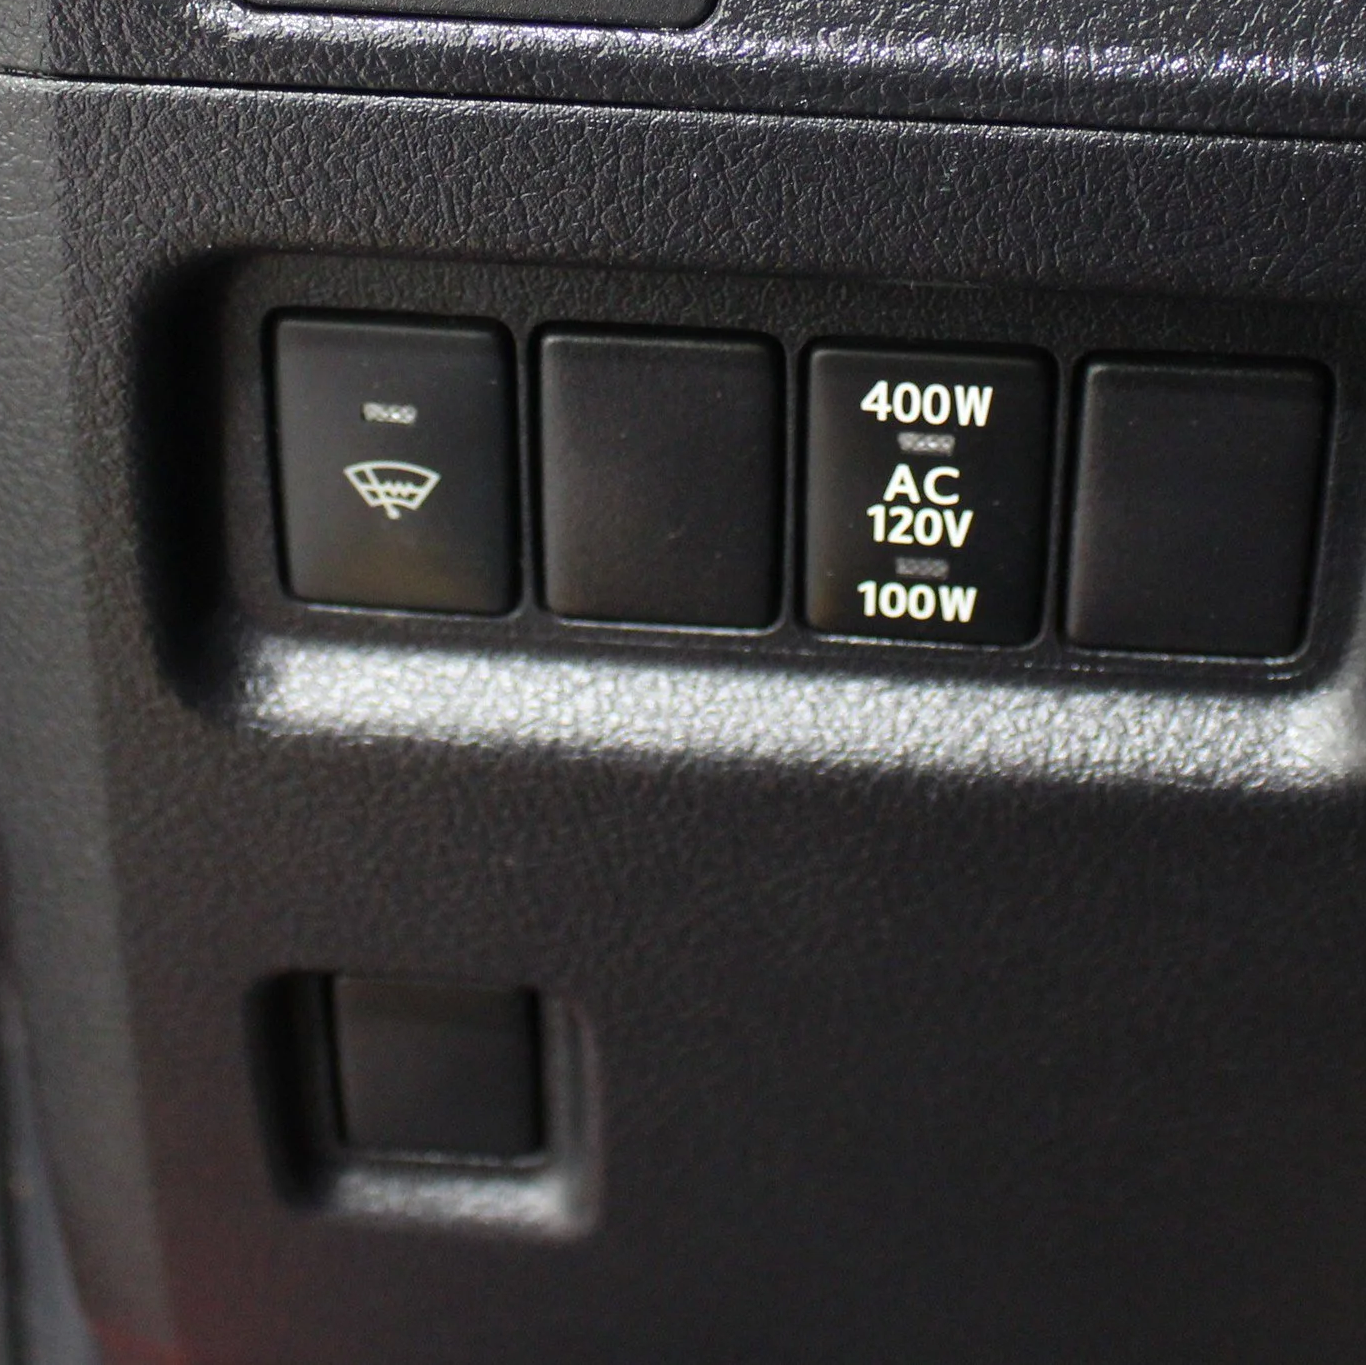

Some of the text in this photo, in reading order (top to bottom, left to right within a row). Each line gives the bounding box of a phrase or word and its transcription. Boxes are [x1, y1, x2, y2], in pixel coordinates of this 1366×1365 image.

[859, 380, 994, 427] 400W
[881, 464, 961, 506] AC
[865, 504, 974, 548] 120V
[856, 580, 978, 623] 100W
